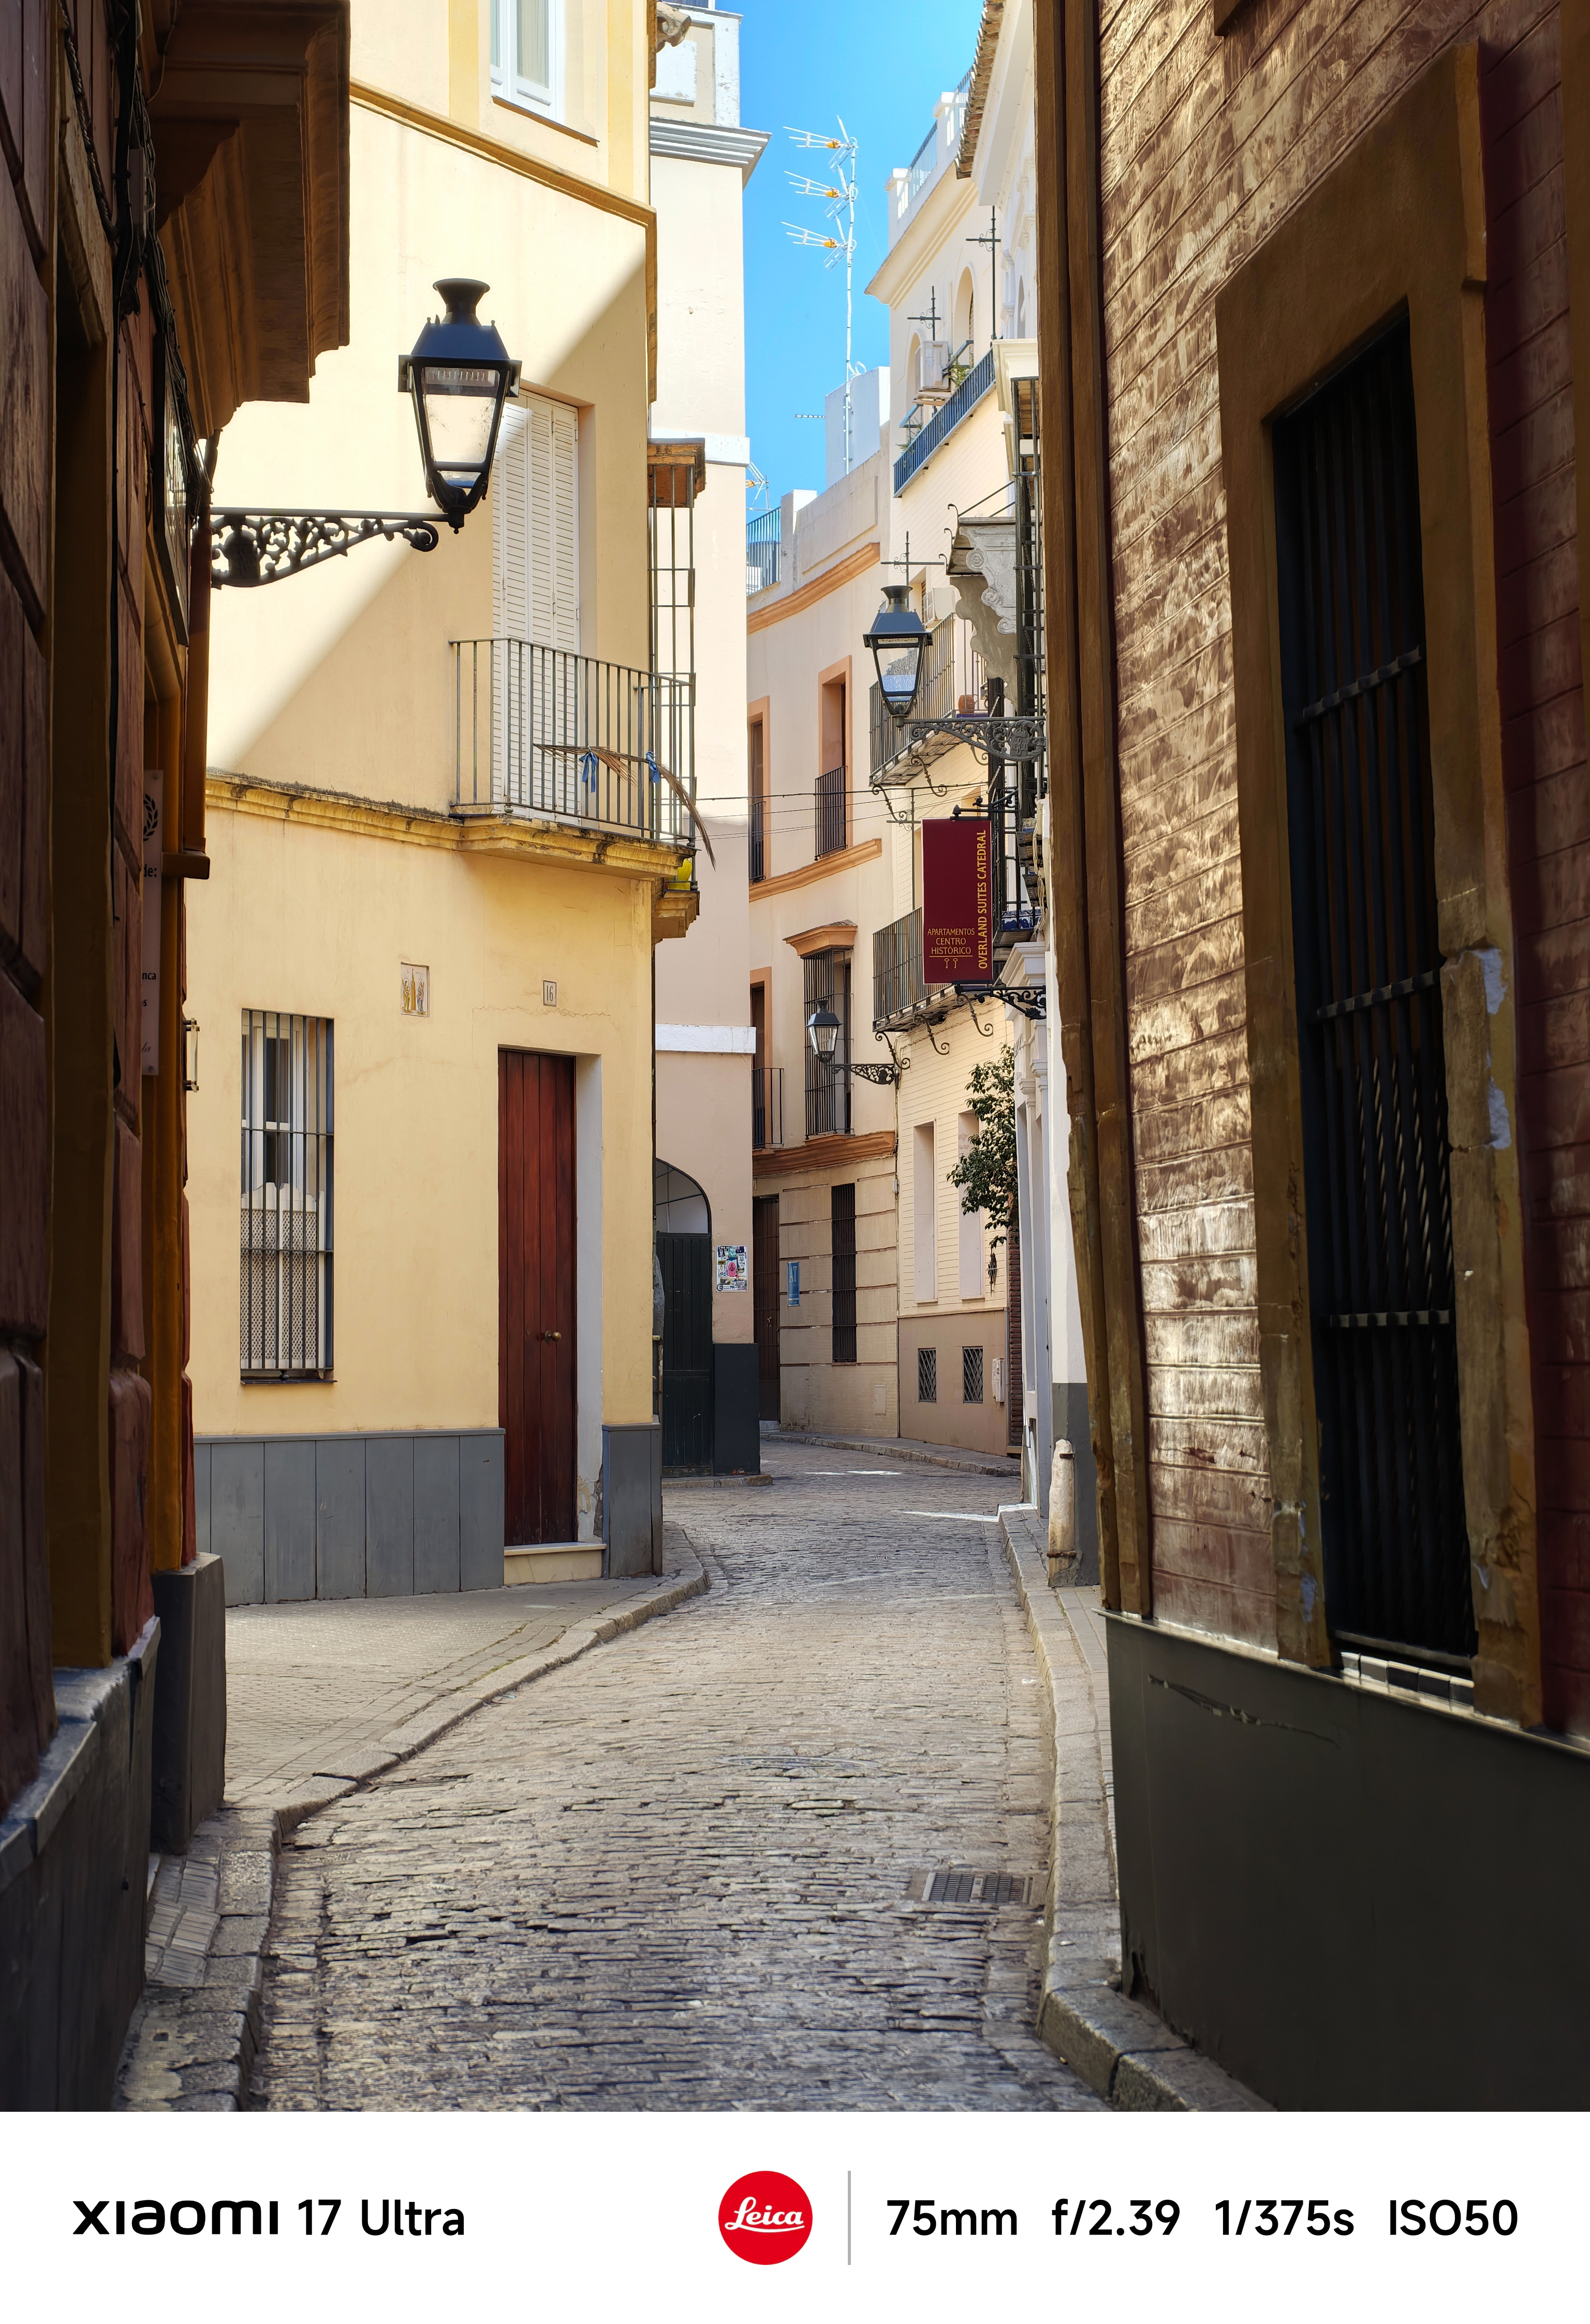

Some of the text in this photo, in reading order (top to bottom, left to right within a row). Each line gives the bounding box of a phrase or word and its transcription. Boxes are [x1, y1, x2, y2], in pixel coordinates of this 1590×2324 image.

[976, 830, 988, 969] OVERLAND SUITES CATEDRAL
[931, 945, 971, 954] HISTÓRICO
[547, 985, 553, 1002] 16
[789, 1266, 798, 1283] AT
